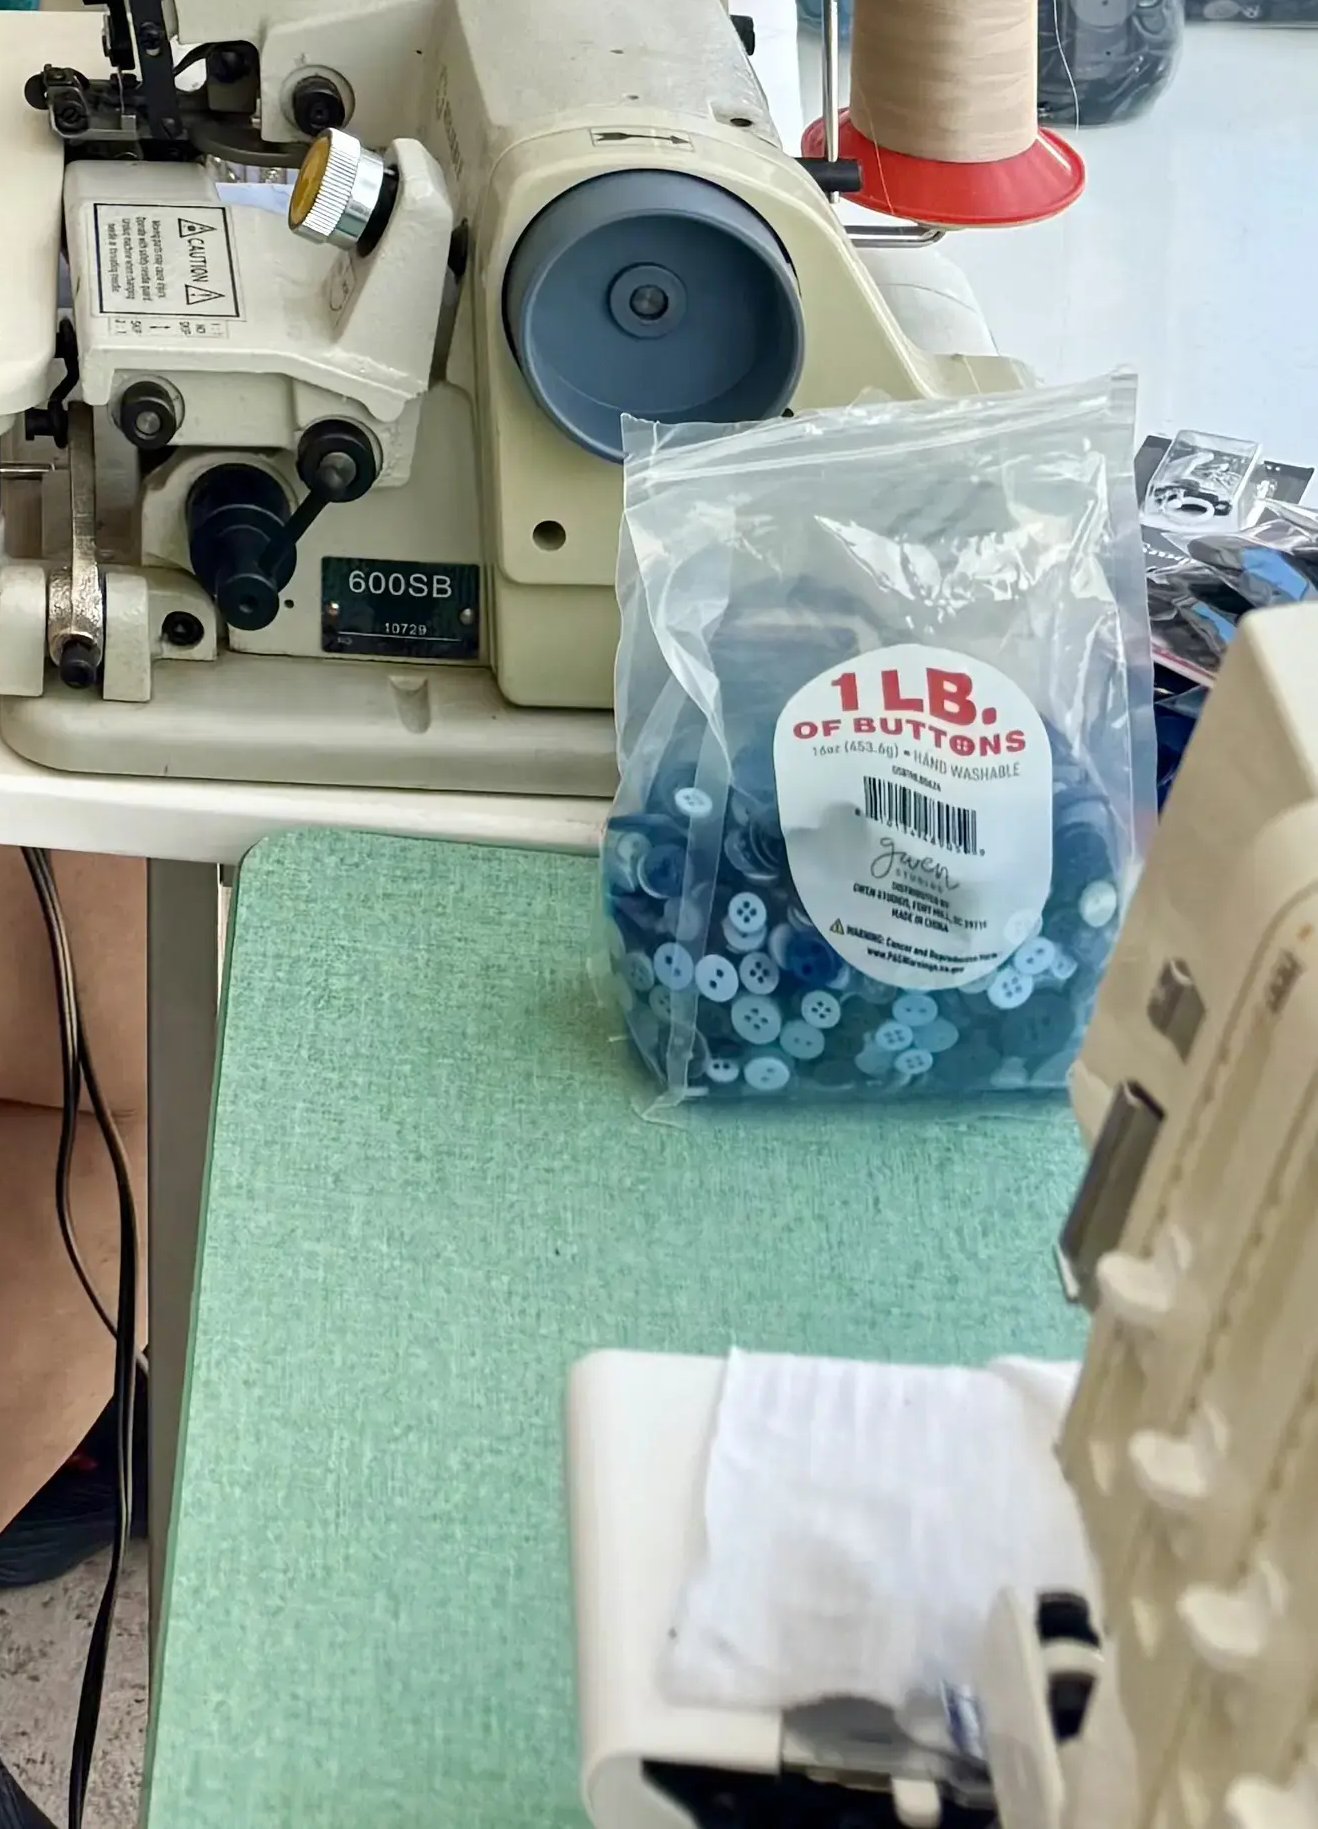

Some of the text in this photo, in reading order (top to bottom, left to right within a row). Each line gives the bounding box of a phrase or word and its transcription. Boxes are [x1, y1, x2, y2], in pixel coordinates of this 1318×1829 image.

[188, 237, 209, 283] CAUTION
[349, 570, 453, 598] 600SB
[831, 667, 997, 727] 1 LB.
[793, 717, 1027, 757] OF BUTTONS
[812, 742, 841, 757] 16oz
[914, 749, 948, 775] HAND
[950, 761, 1021, 782] WASHABLE
[870, 836, 960, 890] gwen
